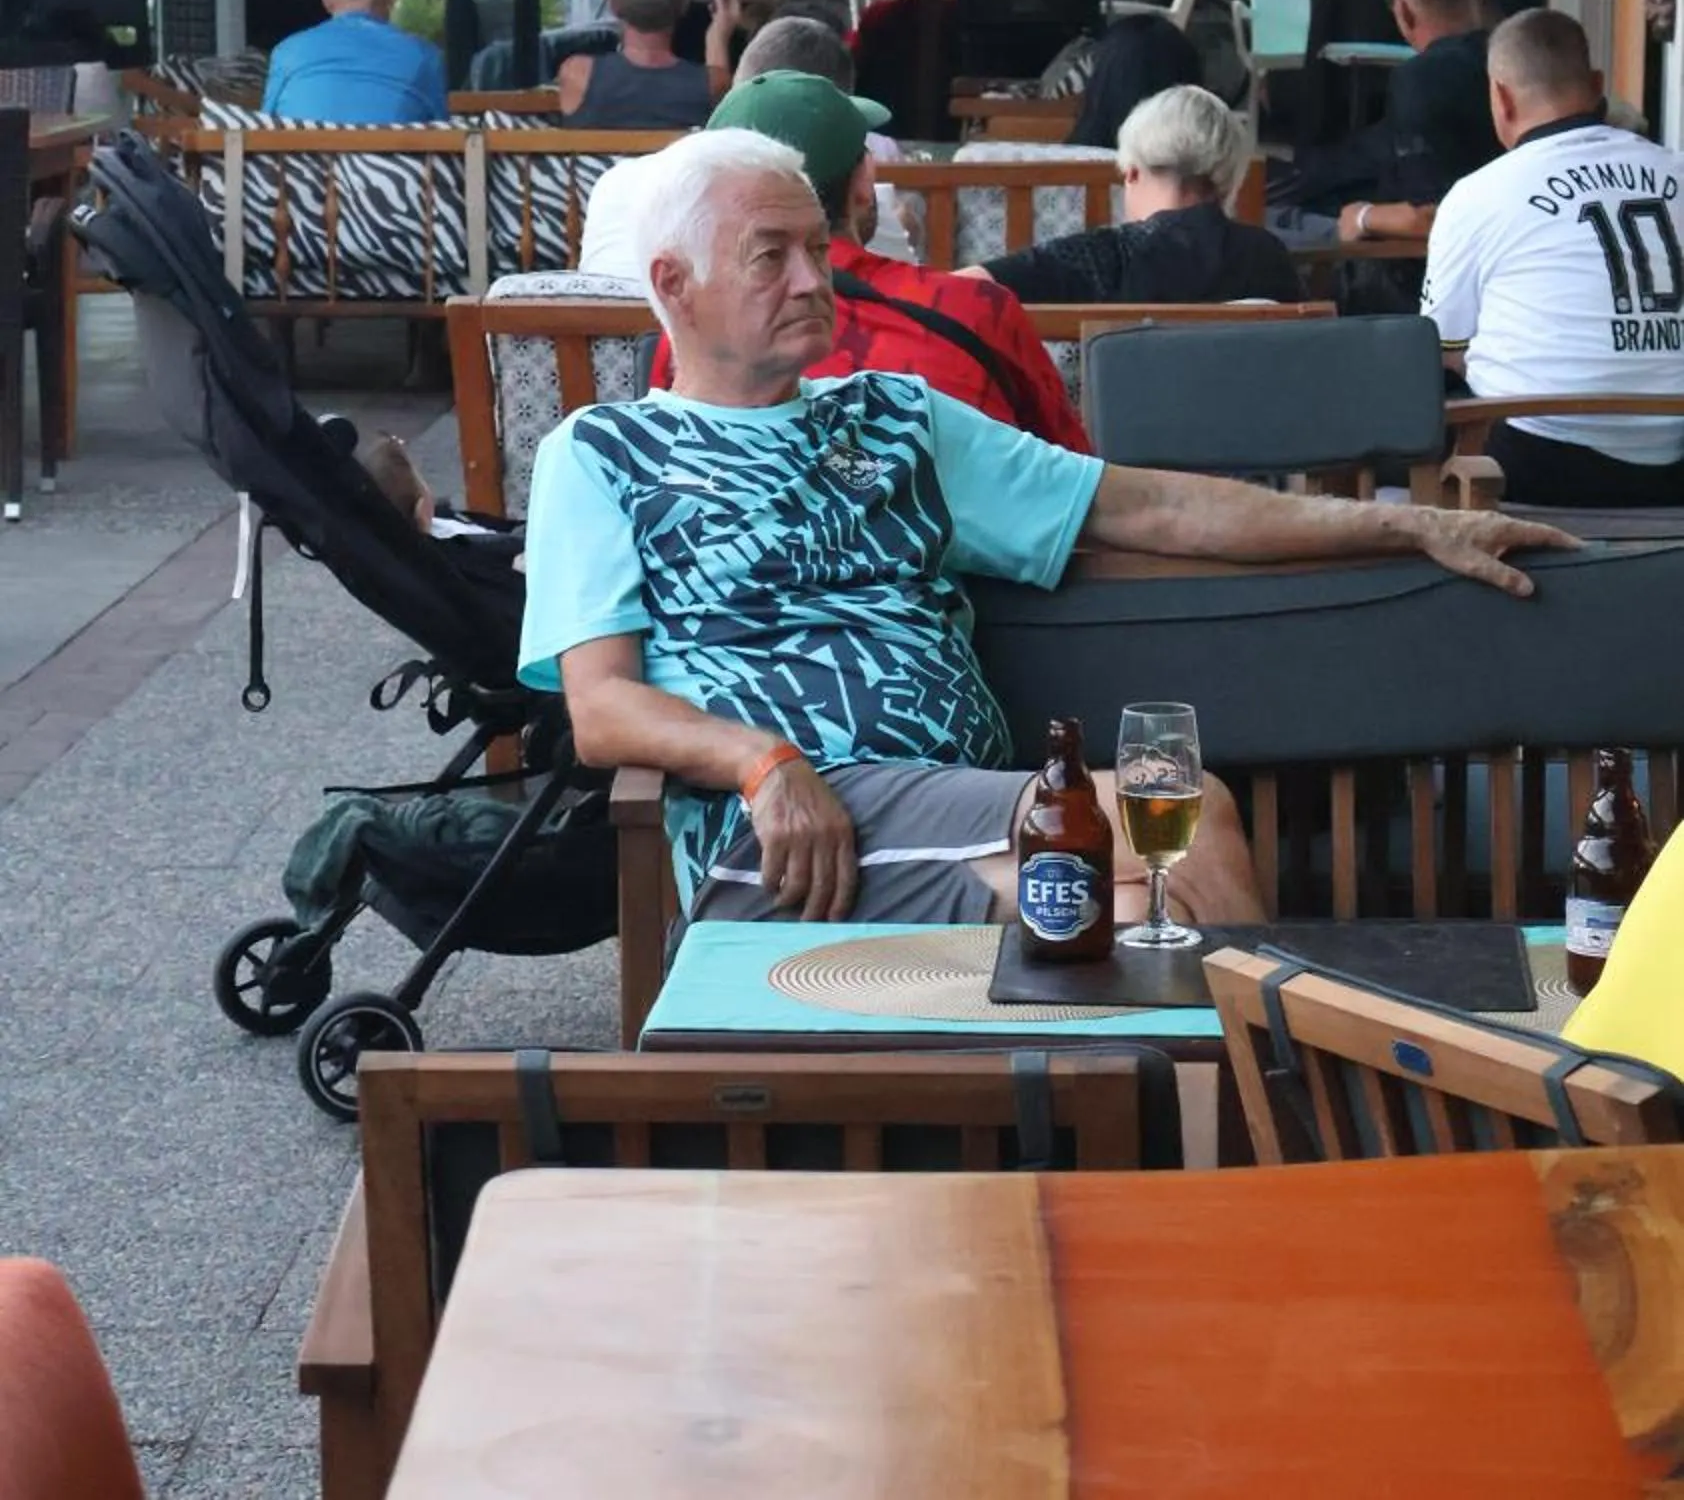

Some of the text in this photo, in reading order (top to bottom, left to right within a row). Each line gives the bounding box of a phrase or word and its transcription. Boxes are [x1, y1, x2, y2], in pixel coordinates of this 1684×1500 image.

[1528, 163, 1678, 216] DORTMUND
[1577, 197, 1684, 315] 10
[1610, 318, 1684, 352] BRAND
[1026, 878, 1089, 905] EFES
